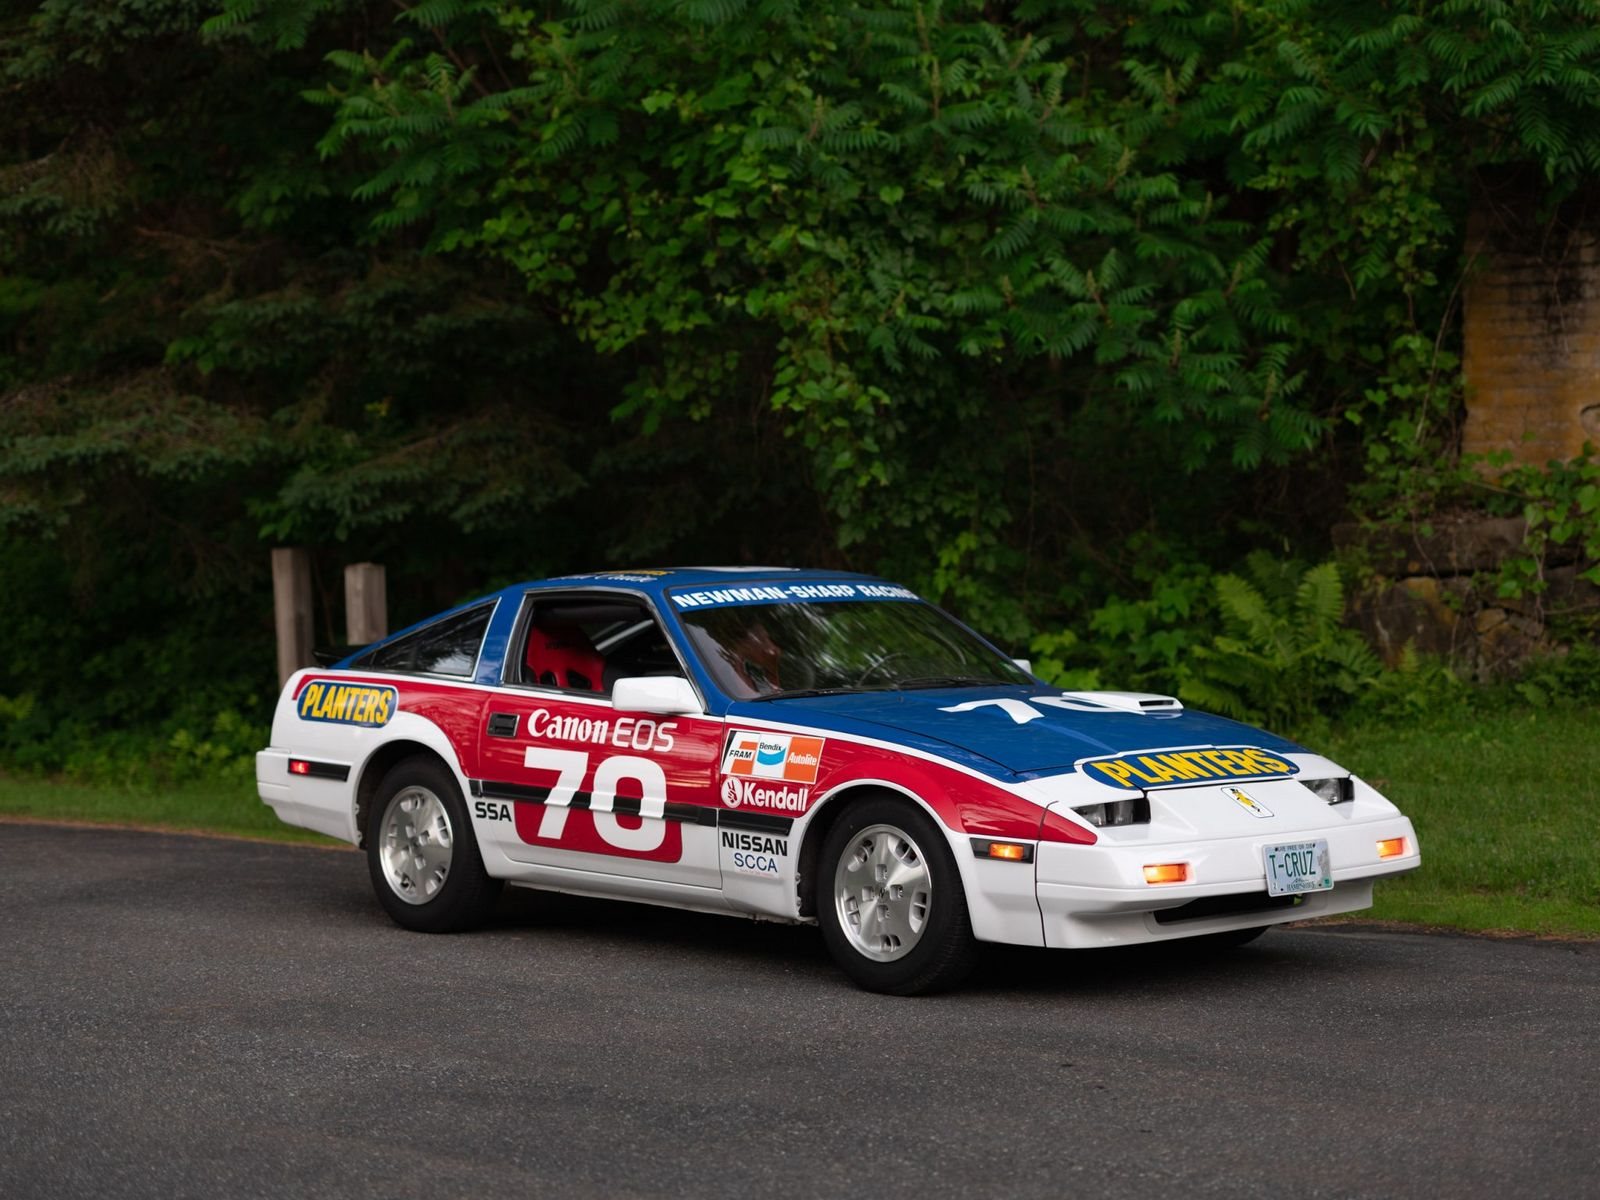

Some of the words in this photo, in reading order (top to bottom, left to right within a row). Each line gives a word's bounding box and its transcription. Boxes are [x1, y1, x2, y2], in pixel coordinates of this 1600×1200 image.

[672, 585, 855, 608] NEWMAN-SHARP
[301, 684, 392, 724] PLANTERS
[527, 708, 609, 744] Canon
[612, 717, 678, 752] EOS
[729, 749, 752, 759] FRAM
[759, 742, 782, 751] Bendix
[787, 751, 818, 766] Autolite
[1091, 748, 1289, 788] PLANTERS
[523, 746, 667, 851] 70
[743, 781, 809, 812] Kendall
[475, 801, 512, 822] SSA
[722, 832, 788, 856] NISSAN
[734, 852, 778, 873] SCCA
[1269, 850, 1316, 879] T-CRUZ
